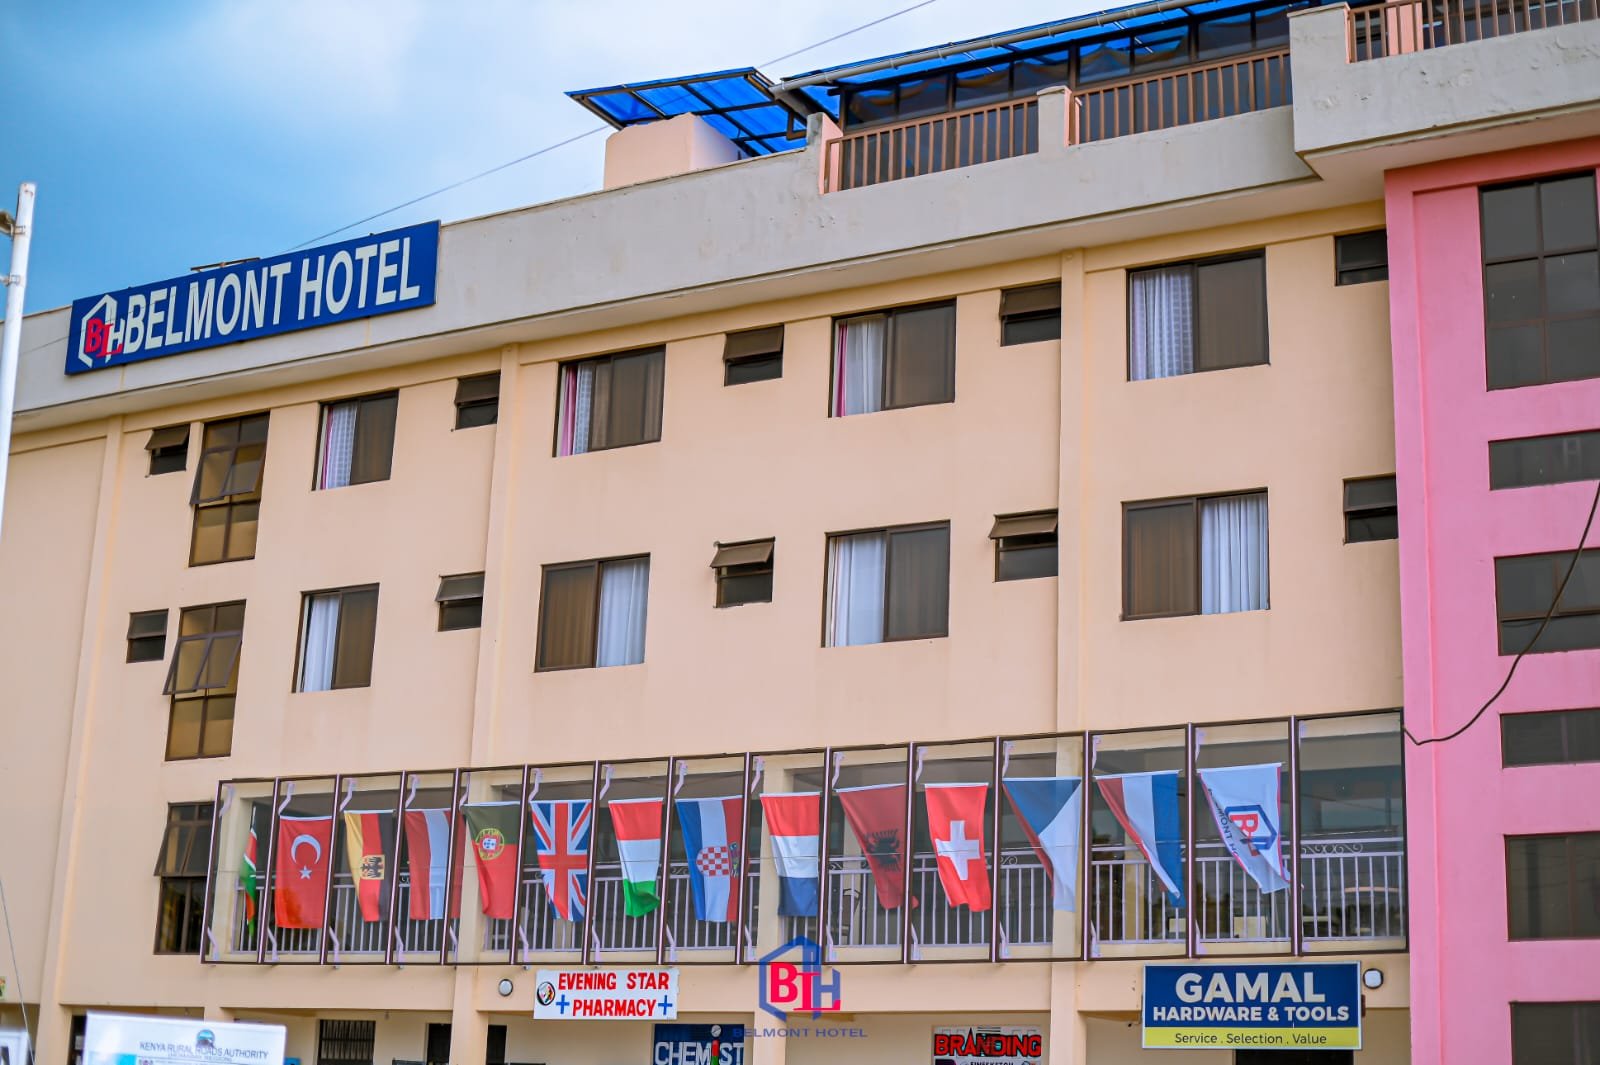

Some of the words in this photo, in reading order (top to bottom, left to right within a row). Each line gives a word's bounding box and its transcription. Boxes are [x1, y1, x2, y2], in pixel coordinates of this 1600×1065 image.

[123, 262, 292, 354] BELMONT
[297, 237, 420, 320] HOTEL
[558, 972, 617, 991] EVENING
[626, 972, 670, 990] STAR
[1175, 972, 1325, 1003] GAMAL
[572, 999, 657, 1017] PHARMACY
[1153, 1005, 1262, 1022] HARDWARE
[1267, 1006, 1280, 1021] &
[1284, 1005, 1350, 1022] TOOLS
[934, 1028, 1042, 1057] BRANDING
[1174, 1032, 1218, 1044] Service
[1226, 1032, 1283, 1044] Selection
[1292, 1032, 1327, 1044] Value
[140, 1042, 166, 1051] KENYA
[167, 1043, 192, 1053] RURAL
[195, 1045, 223, 1056] ROADS
[224, 1048, 269, 1059] AUTHORITY
